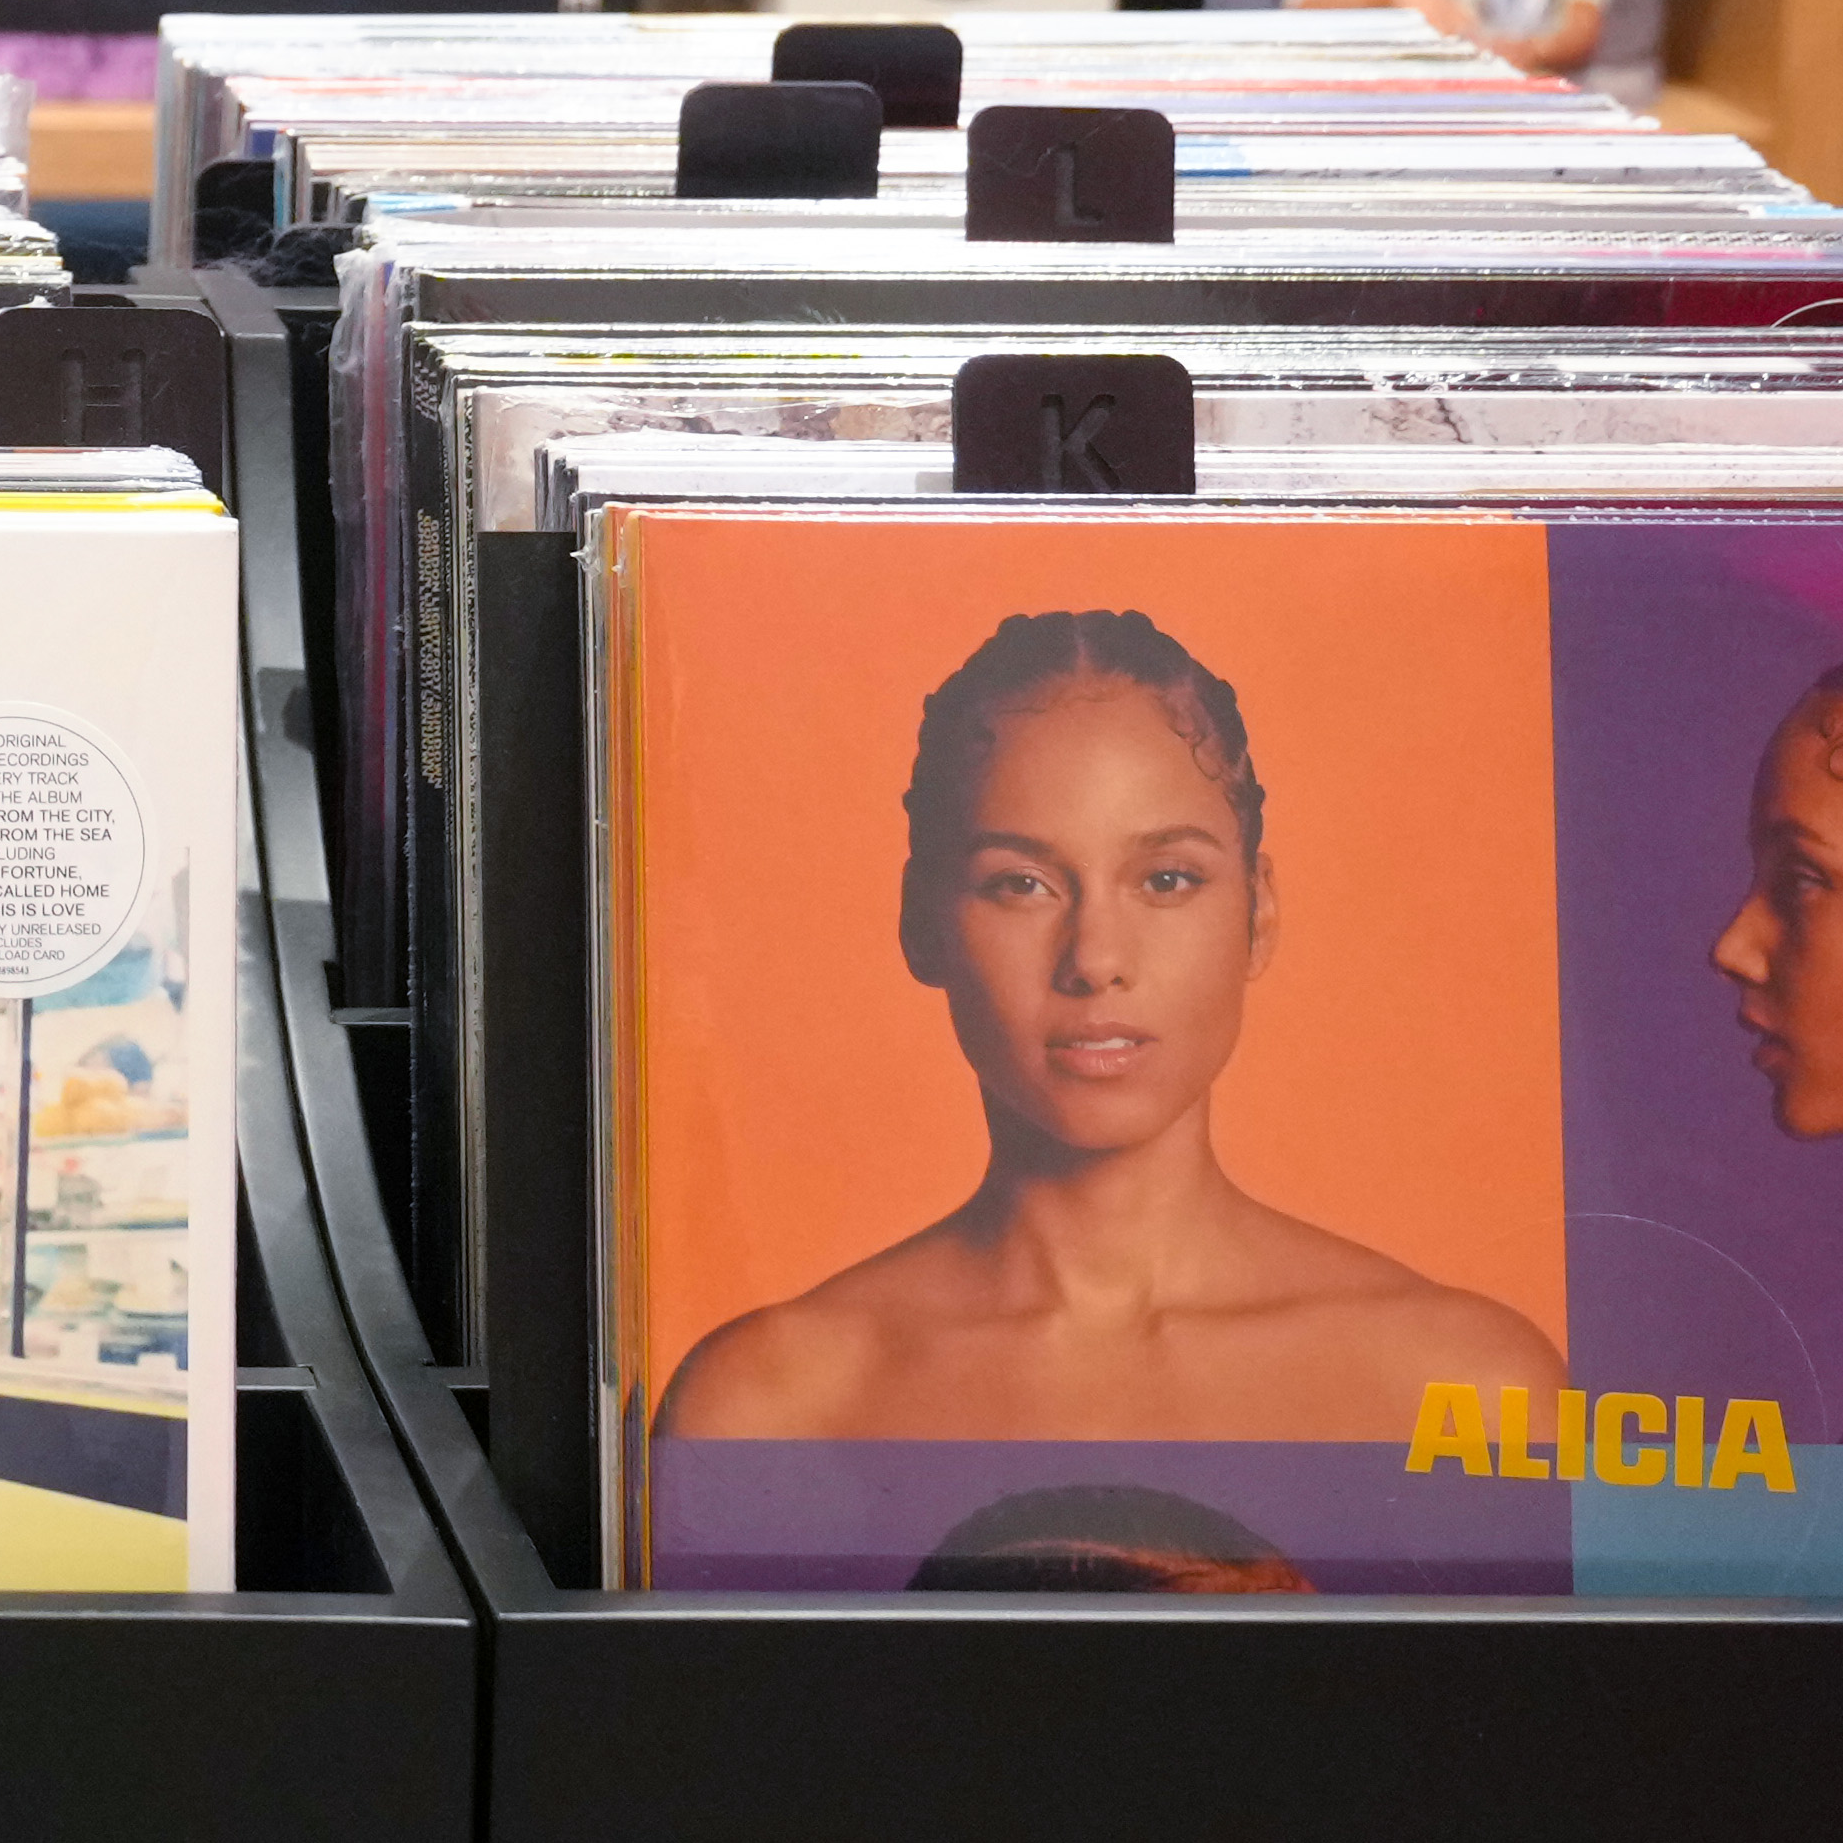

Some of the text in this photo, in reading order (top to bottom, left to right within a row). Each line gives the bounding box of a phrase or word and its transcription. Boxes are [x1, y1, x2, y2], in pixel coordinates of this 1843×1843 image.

[1053, 141, 1105, 229] L
[1038, 392, 1121, 493] K
[28, 771, 79, 785] TRACK
[27, 790, 82, 804] ALBUM
[39, 809, 71, 823] THE
[76, 809, 116, 825] CITY,
[43, 828, 75, 841] THE
[80, 828, 112, 841] SEA
[0, 865, 82, 881] FORTUNE,
[60, 884, 111, 898] HOME
[21, 903, 37, 917] IS
[42, 903, 85, 917] LOVE
[11, 923, 102, 936] UNRELEASED
[33, 950, 66, 961] CARD
[1404, 1382, 1797, 1493] ALICIA
